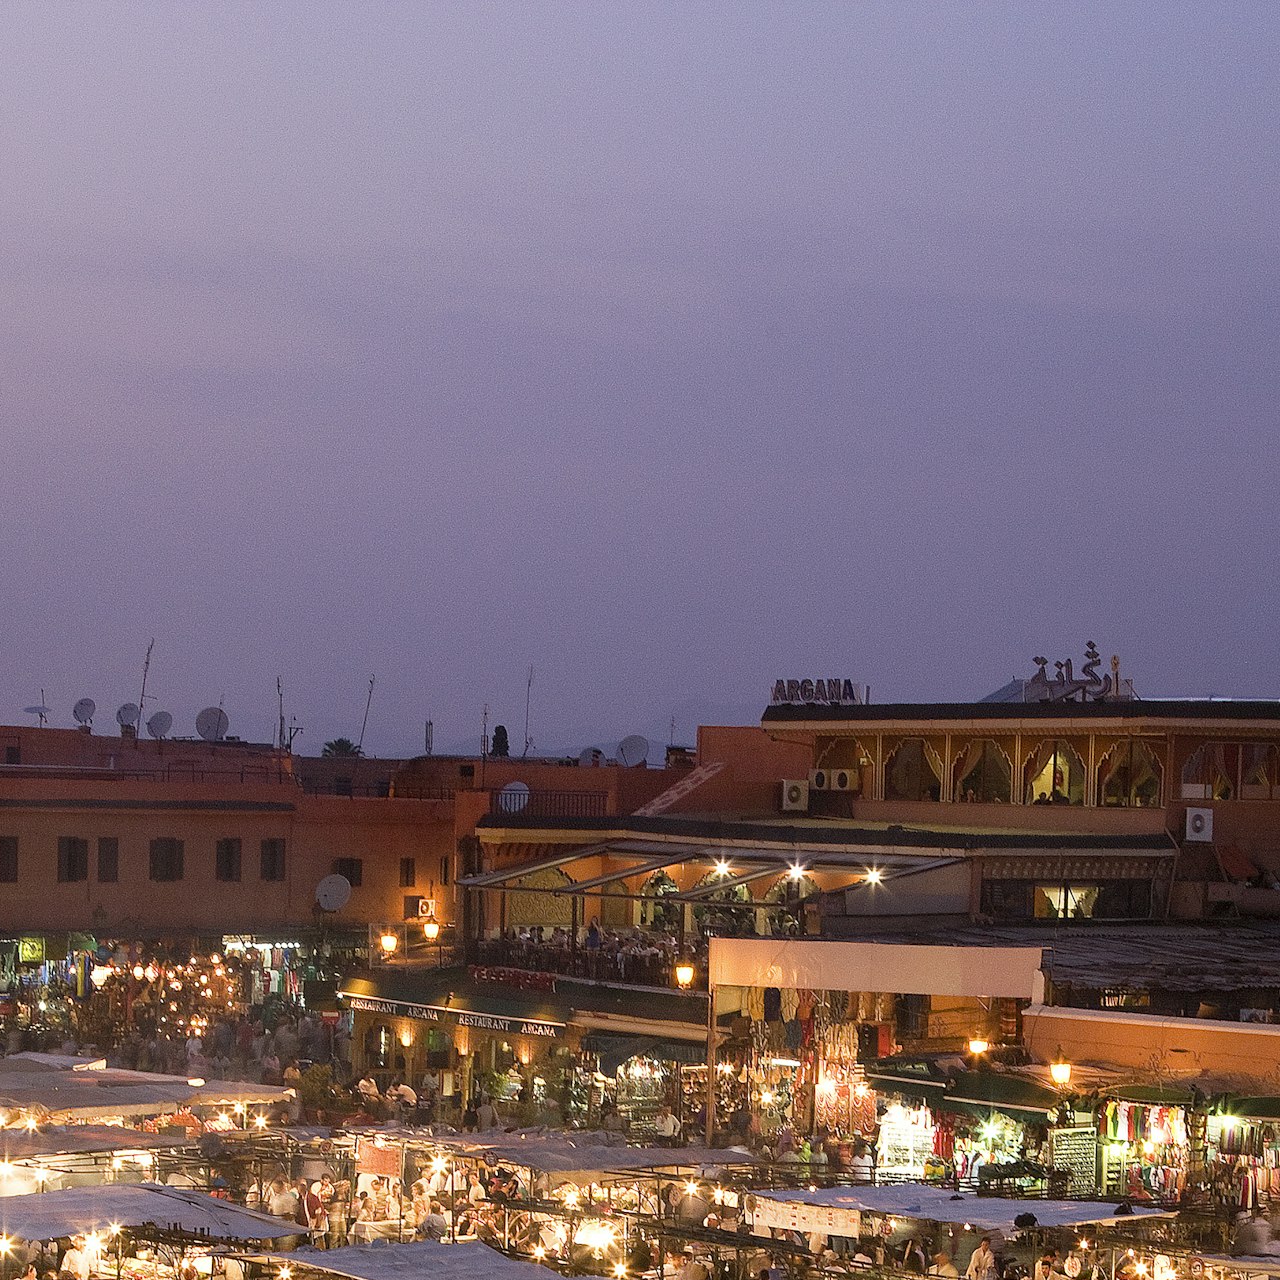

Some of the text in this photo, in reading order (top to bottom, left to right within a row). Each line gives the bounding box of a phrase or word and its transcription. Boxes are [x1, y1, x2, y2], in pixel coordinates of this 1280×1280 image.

[773, 679, 855, 701] ARGANA
[350, 999, 398, 1015] RESTAURANT
[458, 1013, 510, 1031] RESTAURANT
